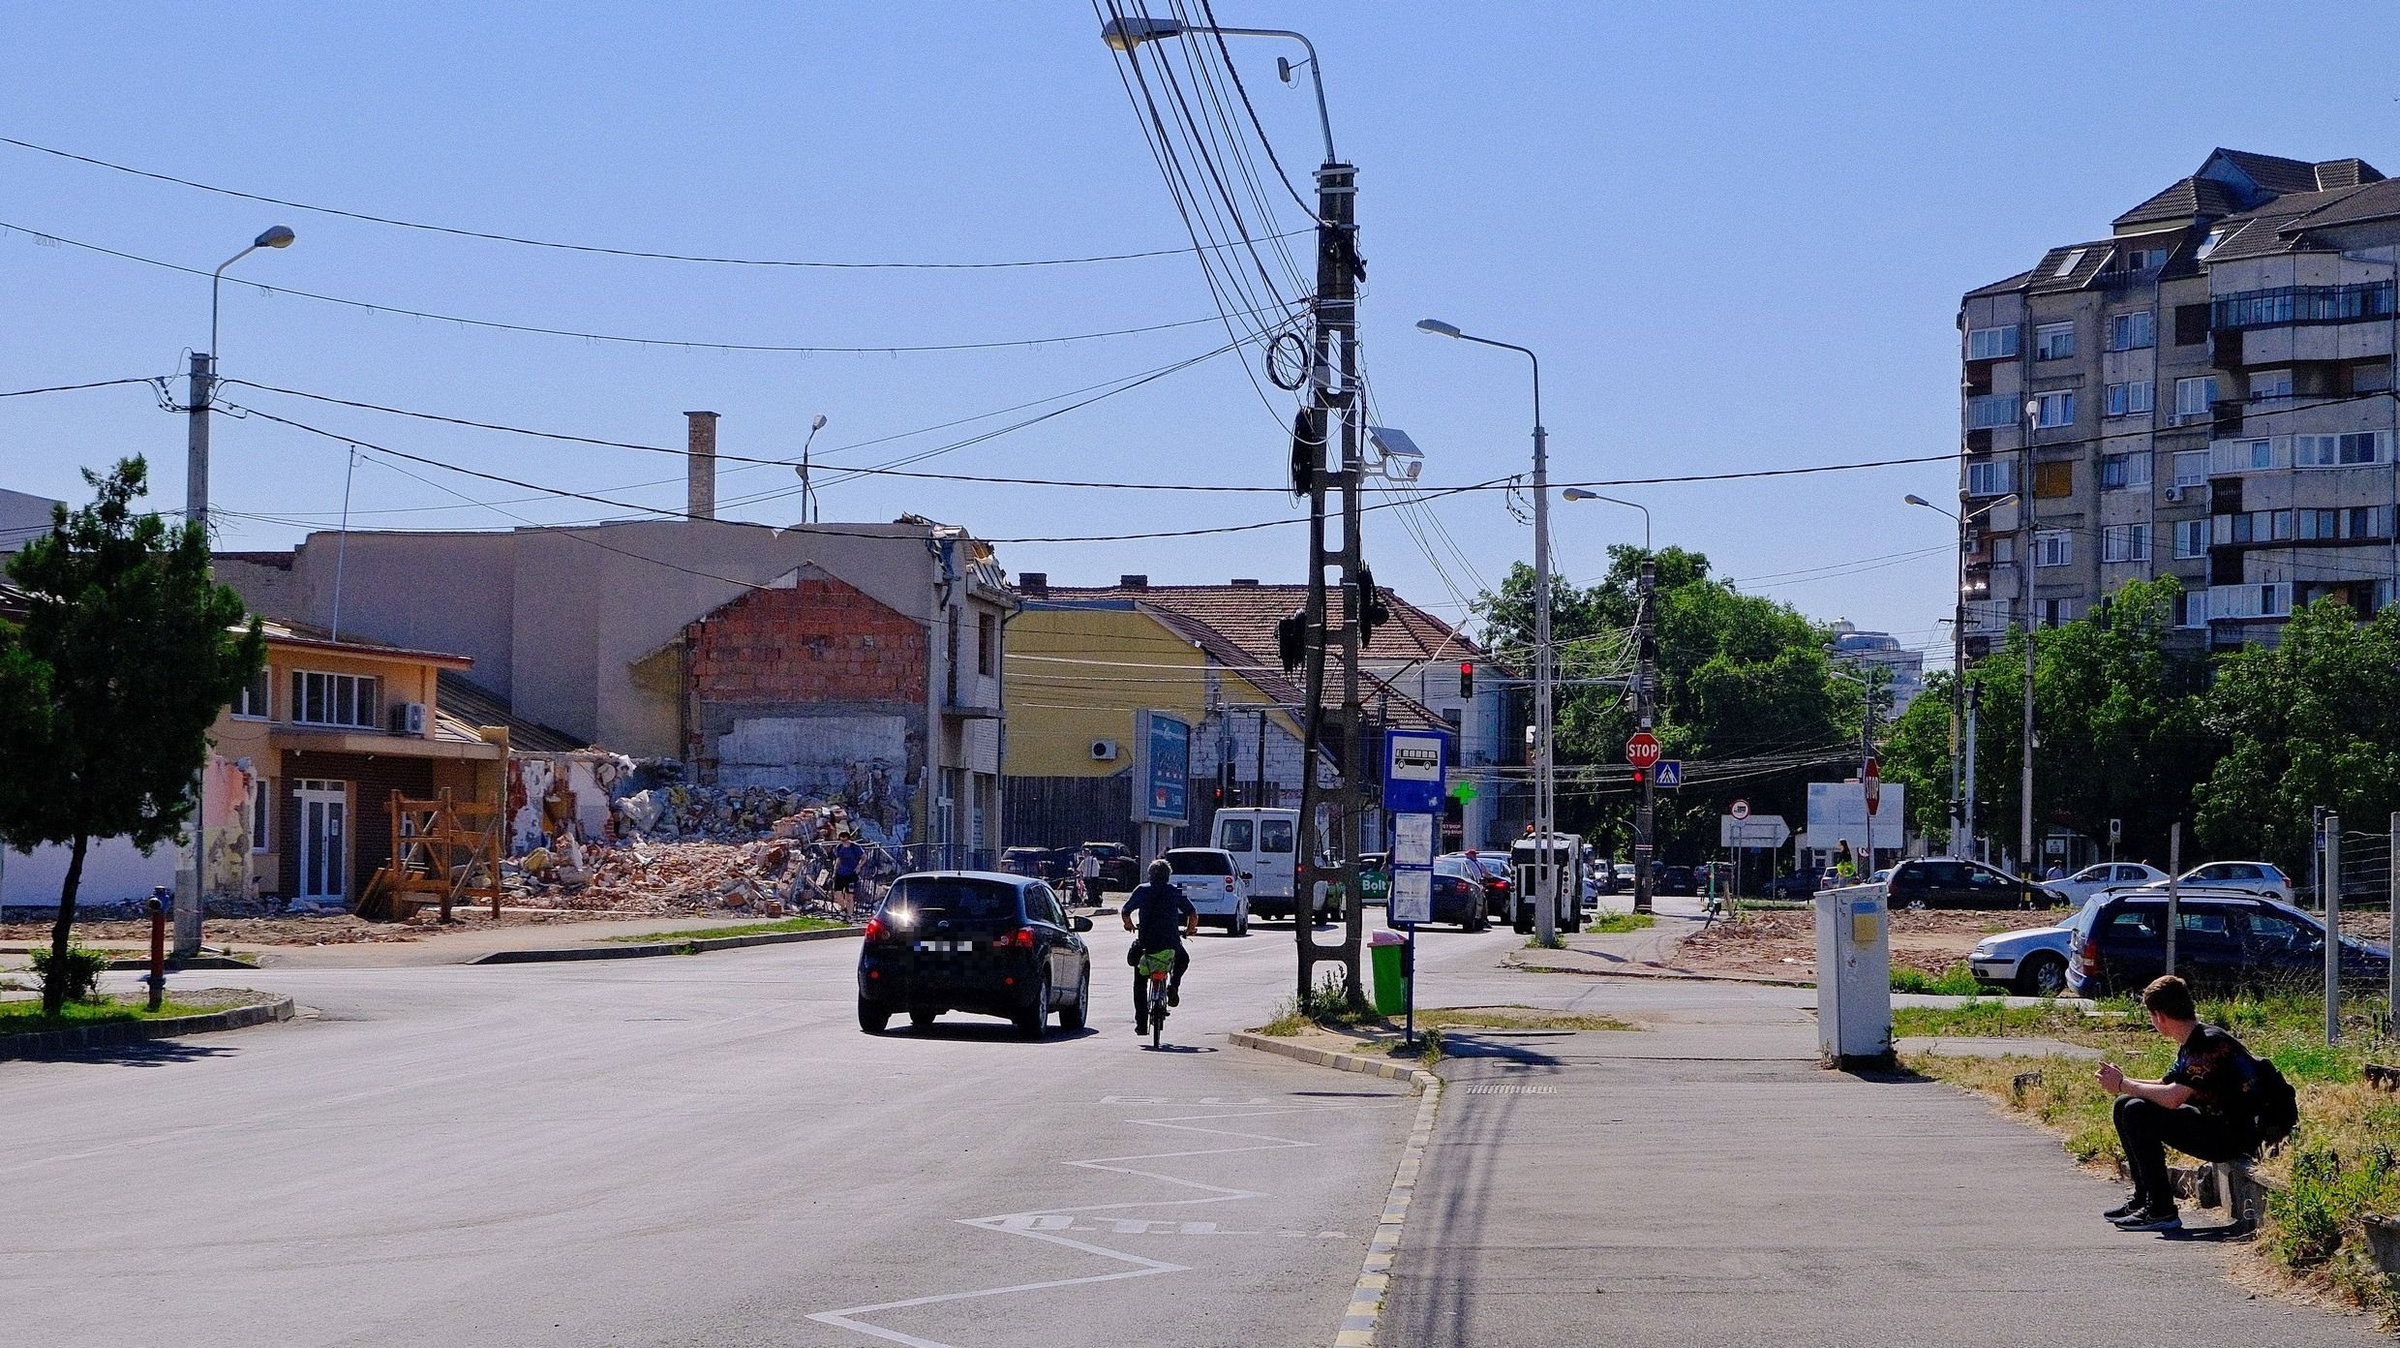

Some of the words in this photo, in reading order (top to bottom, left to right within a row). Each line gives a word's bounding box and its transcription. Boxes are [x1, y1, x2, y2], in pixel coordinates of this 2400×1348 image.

[1628, 744, 1658, 757] STOP
[1865, 776, 1879, 801] STOP
[1362, 880, 1387, 891] Bolt
